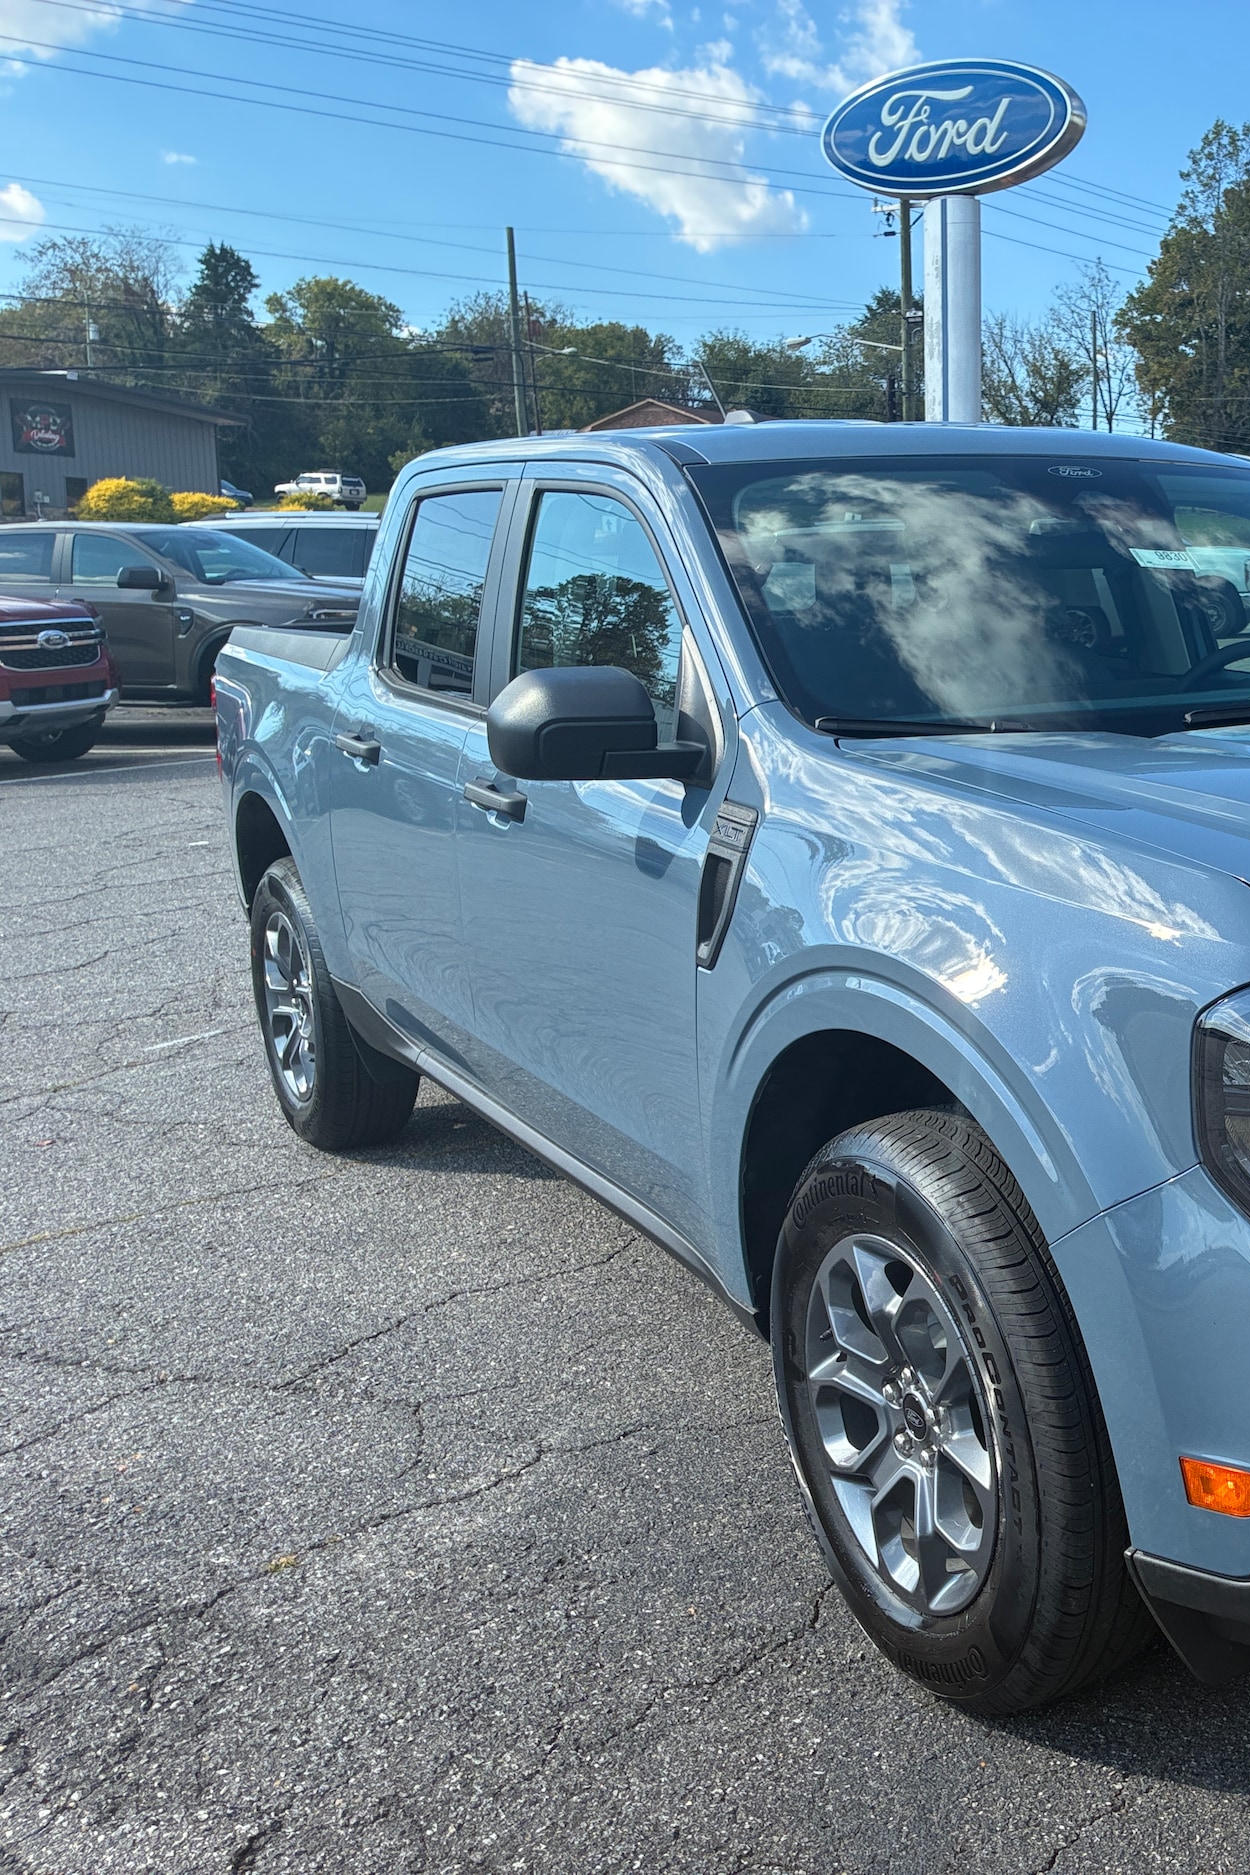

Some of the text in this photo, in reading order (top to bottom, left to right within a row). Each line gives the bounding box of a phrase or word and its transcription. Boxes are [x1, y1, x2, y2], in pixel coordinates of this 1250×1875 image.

[868, 85, 1013, 167] Ford
[1059, 466, 1094, 476] Ford
[1154, 551, 1189, 562] 9830
[713, 821, 744, 842] XLT
[793, 1169, 865, 1231] Continental
